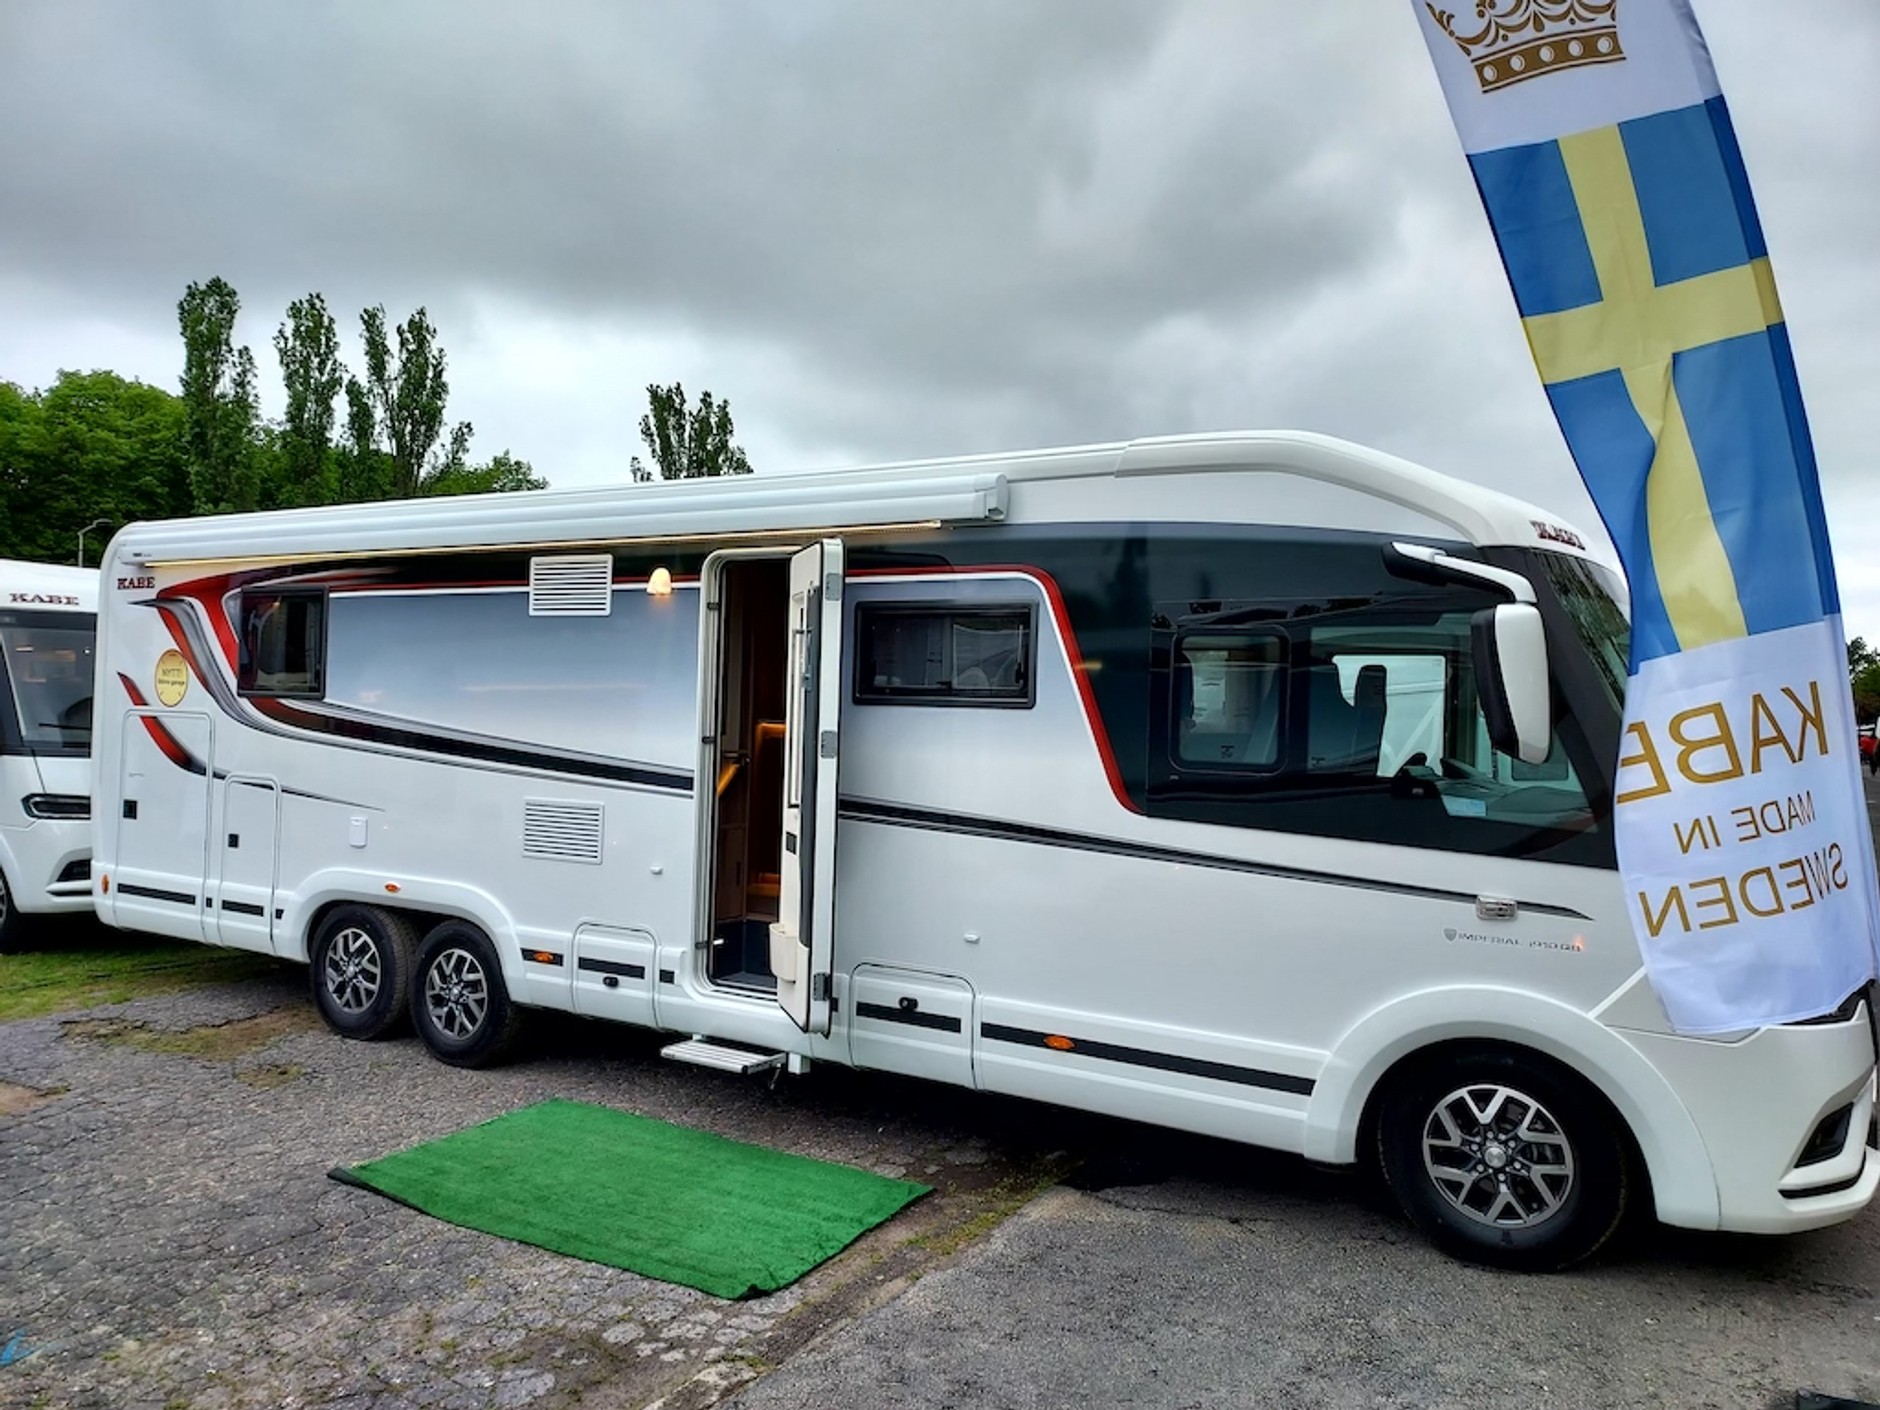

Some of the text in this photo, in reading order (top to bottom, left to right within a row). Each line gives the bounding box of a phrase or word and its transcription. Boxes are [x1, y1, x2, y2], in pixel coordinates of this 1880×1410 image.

[117, 576, 156, 590] KABE
[9, 593, 79, 605] KABE
[1458, 931, 1521, 946] IMPERIAL
